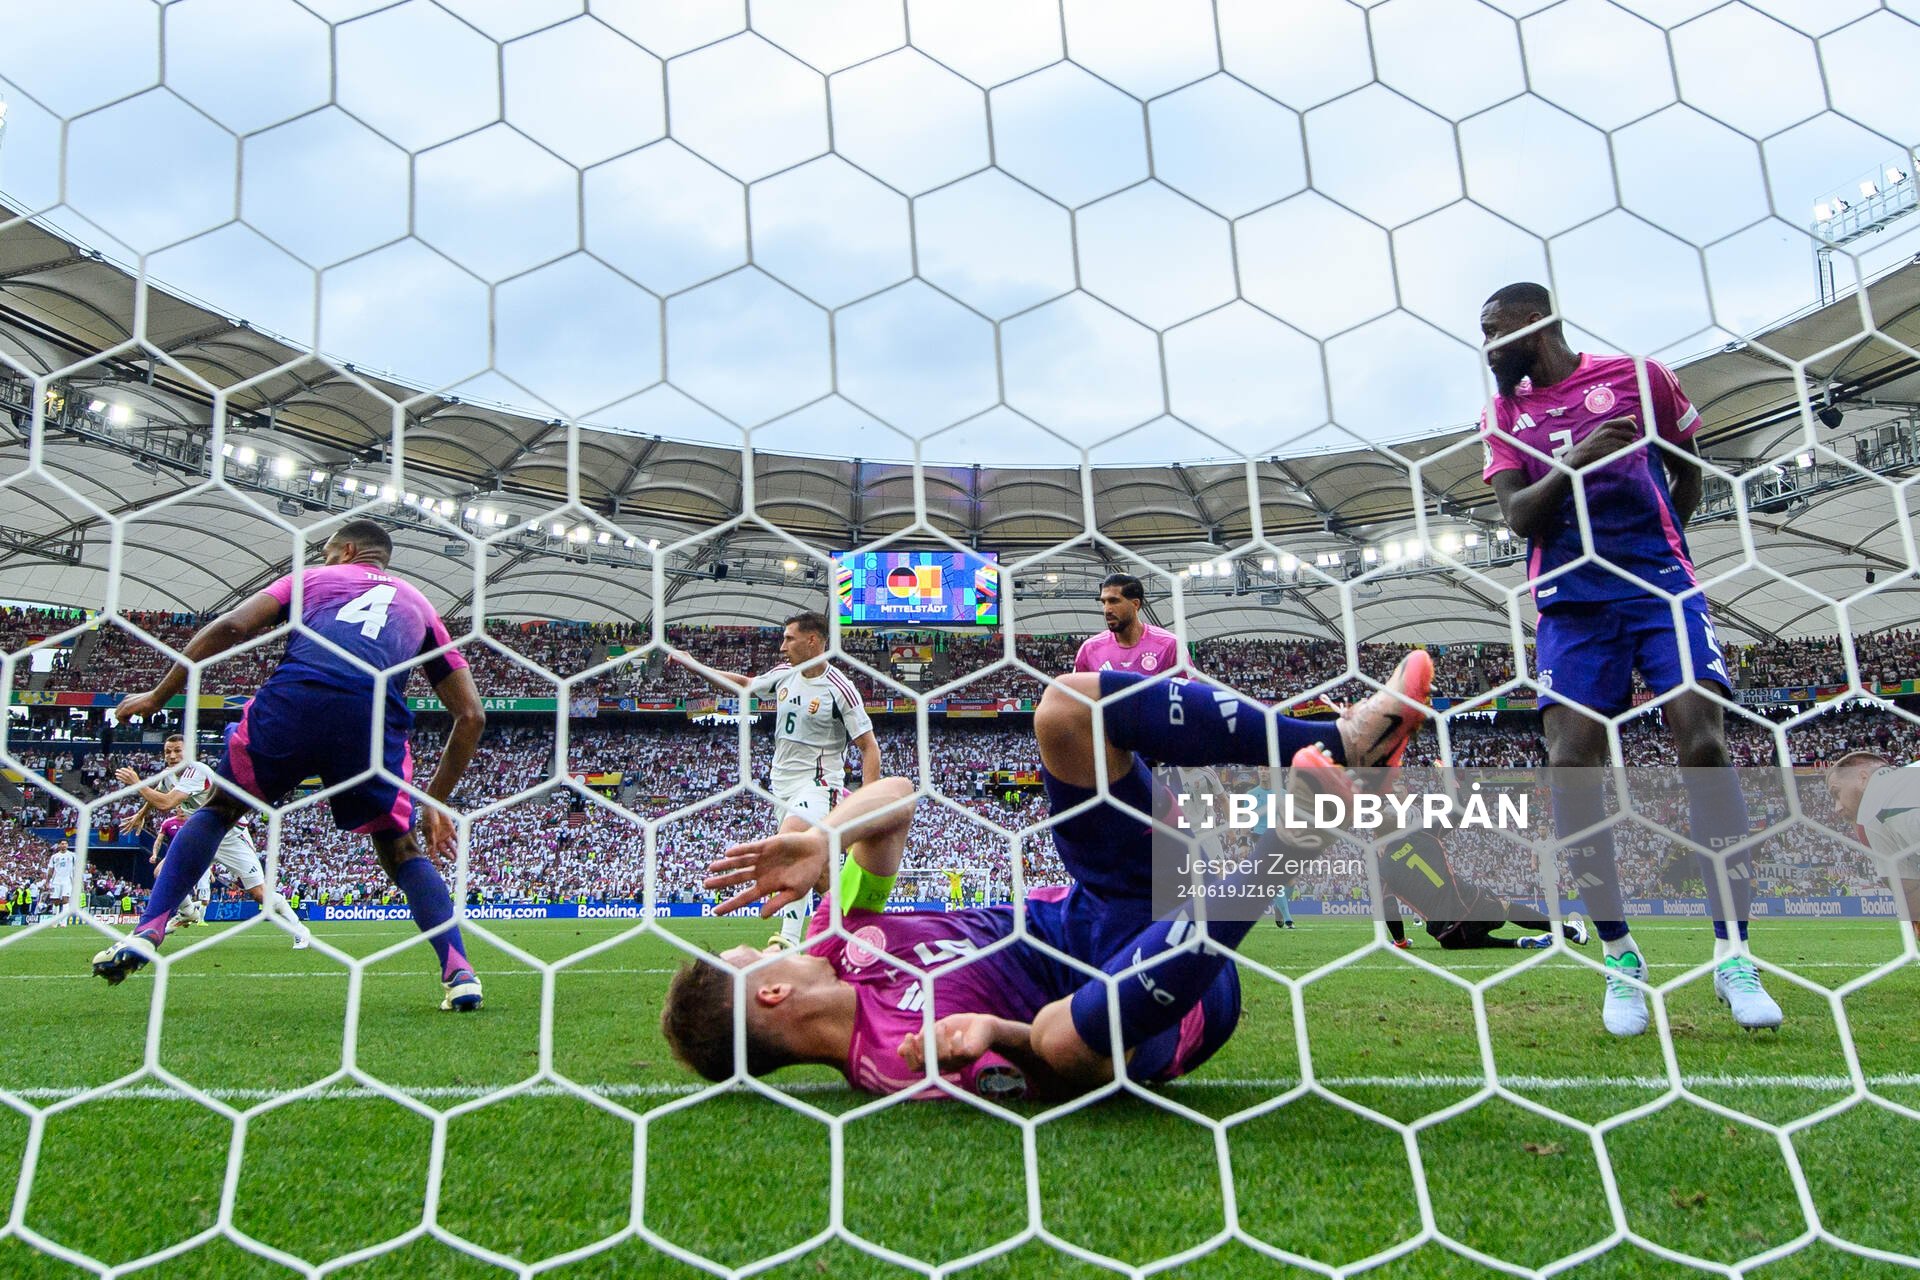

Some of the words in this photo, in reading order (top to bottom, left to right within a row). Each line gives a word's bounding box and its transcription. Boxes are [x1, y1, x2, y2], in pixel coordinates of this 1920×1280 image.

[335, 583, 398, 641] 4
[880, 604, 947, 613] MITTELSTÄDT
[1743, 689, 1773, 697] SOEST
[1743, 696, 1773, 704] RULES
[416, 699, 517, 709] START
[785, 711, 797, 735] 6
[1406, 853, 1445, 889] 1
[454, 905, 547, 920] ooking.com
[1622, 901, 1652, 916] king.com
[1663, 900, 1706, 917] Booking.com
[1784, 898, 1842, 917] Booking.com
[1861, 897, 1898, 915] Bookin
